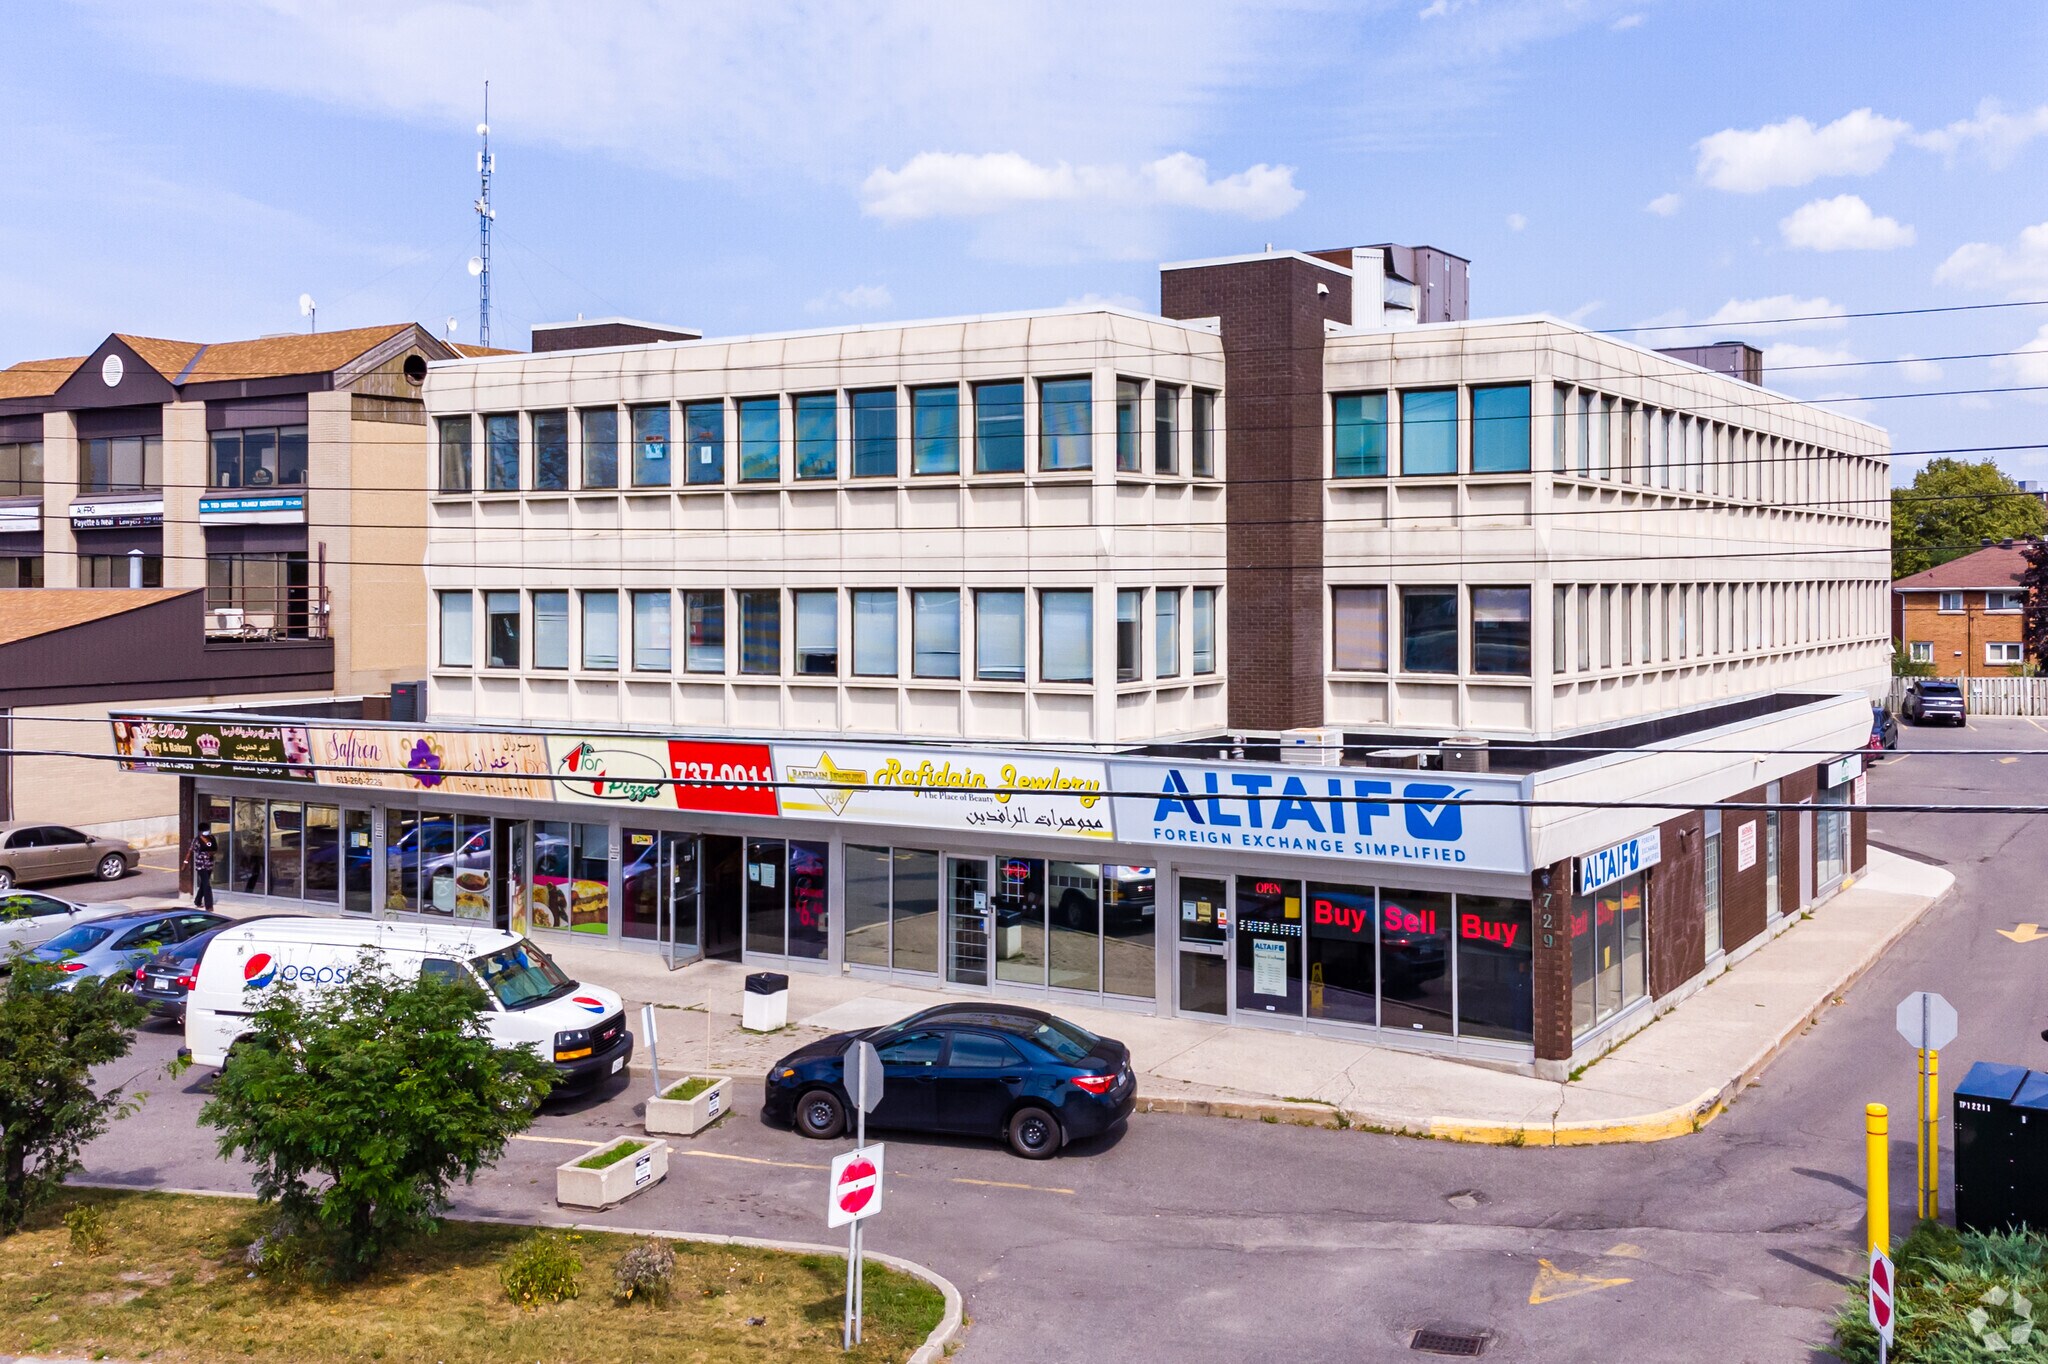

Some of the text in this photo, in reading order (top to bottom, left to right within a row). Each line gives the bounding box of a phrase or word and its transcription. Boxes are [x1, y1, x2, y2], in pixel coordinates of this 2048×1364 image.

[74, 518, 95, 528] Payette
[158, 723, 188, 739] Roi
[162, 742, 169, 751] &
[169, 742, 192, 755] Bakery
[327, 730, 382, 766] Saffron
[581, 744, 603, 771] for
[675, 761, 774, 793] 737-0011
[874, 758, 1101, 808] Rafidain Jewlery
[607, 780, 659, 801] Pizza
[924, 791, 994, 804] The Place of Beauty
[1154, 769, 1392, 836] ALTAIF
[966, 806, 1104, 833] مجوهرات الرافدين
[1154, 828, 1466, 862] FOREIGN EXCHANGE SIMPLIFIED
[1584, 843, 1628, 892] ALTAIF
[1256, 882, 1281, 894] OPEN
[1314, 900, 1367, 933] Buy
[1384, 905, 1436, 934] Sell
[1461, 914, 1519, 948] Buy
[1255, 942, 1279, 952] ALTAIF
[281, 965, 352, 988] pepsi
[1959, 1100, 1991, 1112] TP12211
